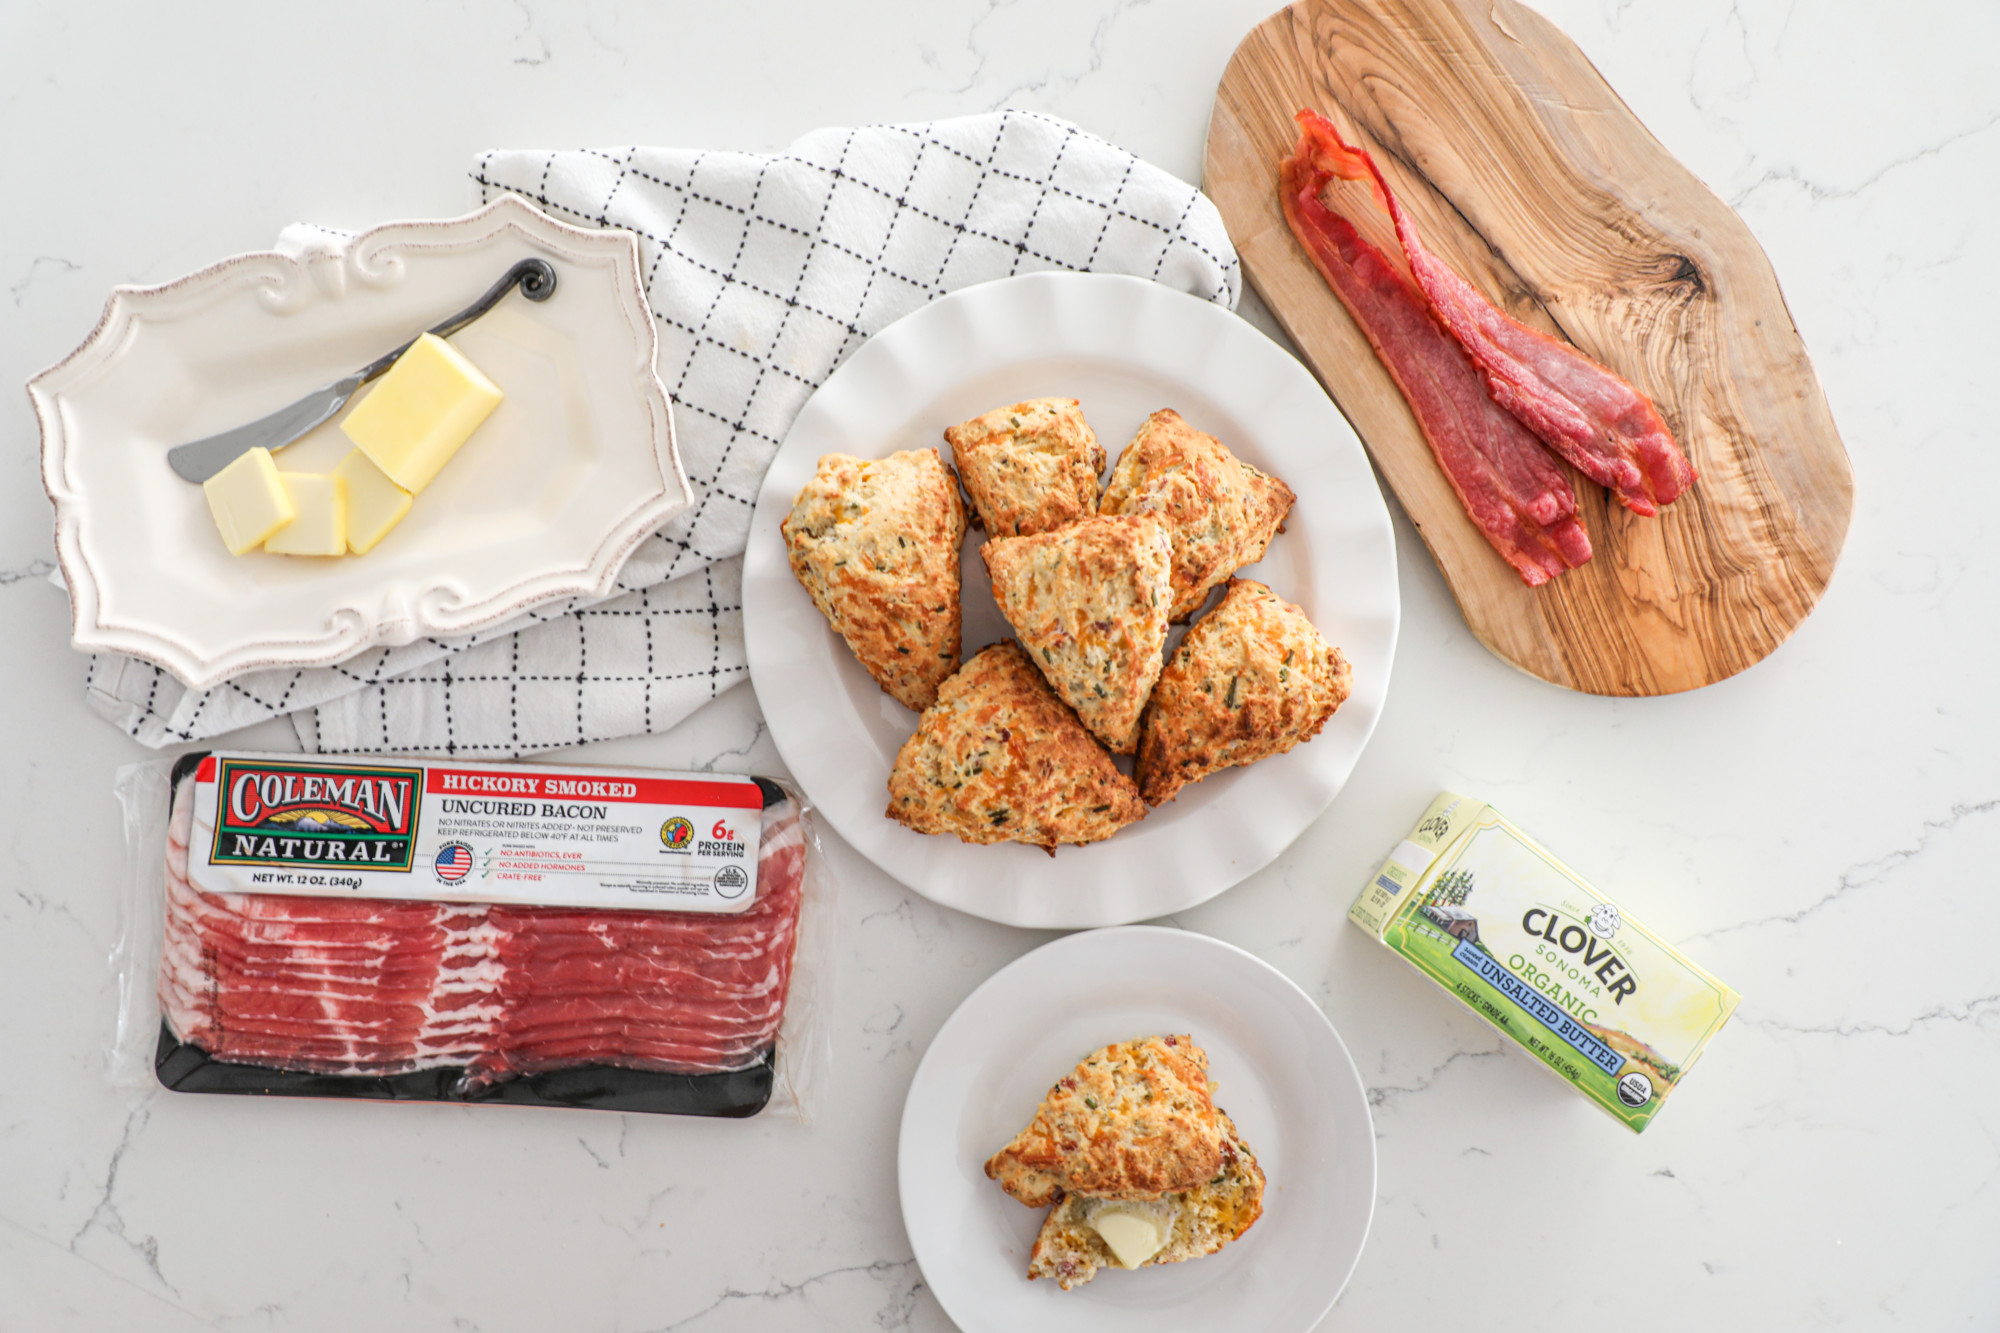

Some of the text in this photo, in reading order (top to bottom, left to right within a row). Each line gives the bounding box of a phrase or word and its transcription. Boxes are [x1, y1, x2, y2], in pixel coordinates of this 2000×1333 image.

[442, 774, 637, 798] HICKORY SMOKED
[231, 773, 409, 831] COLEMAN
[441, 799, 608, 820] UNCURED BACON
[437, 828, 458, 836] KEEP
[459, 829, 519, 839] REFRIGERATED
[520, 831, 549, 840] BELOW
[569, 833, 580, 841] AT
[582, 833, 594, 842] ALL
[595, 835, 619, 843] TIMES
[438, 818, 453, 827] NO
[454, 819, 491, 828] NITRATES
[492, 821, 505, 829] OR
[506, 821, 540, 830] NITRITES
[577, 825, 594, 833] NOT
[595, 825, 643, 835] PRESERVED
[232, 834, 391, 862] NATURAL
[500, 849, 512, 858] NO
[513, 850, 561, 859] ANTIBIOTICS,
[698, 841, 745, 851] PROTEIN
[712, 850, 745, 858] SERVING
[498, 861, 586, 871] NO ADDED HORMONES
[252, 873, 362, 890] NET WT. 12 OZ. (340g)
[1522, 908, 1637, 1006] CLOVER
[1536, 944, 1601, 998] SONOMA
[1509, 954, 1598, 1025] ORGANIC
[1456, 982, 1510, 1026] 4 STICKS GRADE AA
[1481, 960, 1618, 1071] UNSALTED BUTTER
[1528, 1036, 1542, 1048] NET
[1548, 1051, 1556, 1060] 16
[1553, 1056, 1565, 1066] OZ
[1561, 1062, 1581, 1081] (454g)
[1629, 1077, 1647, 1093] USDA
